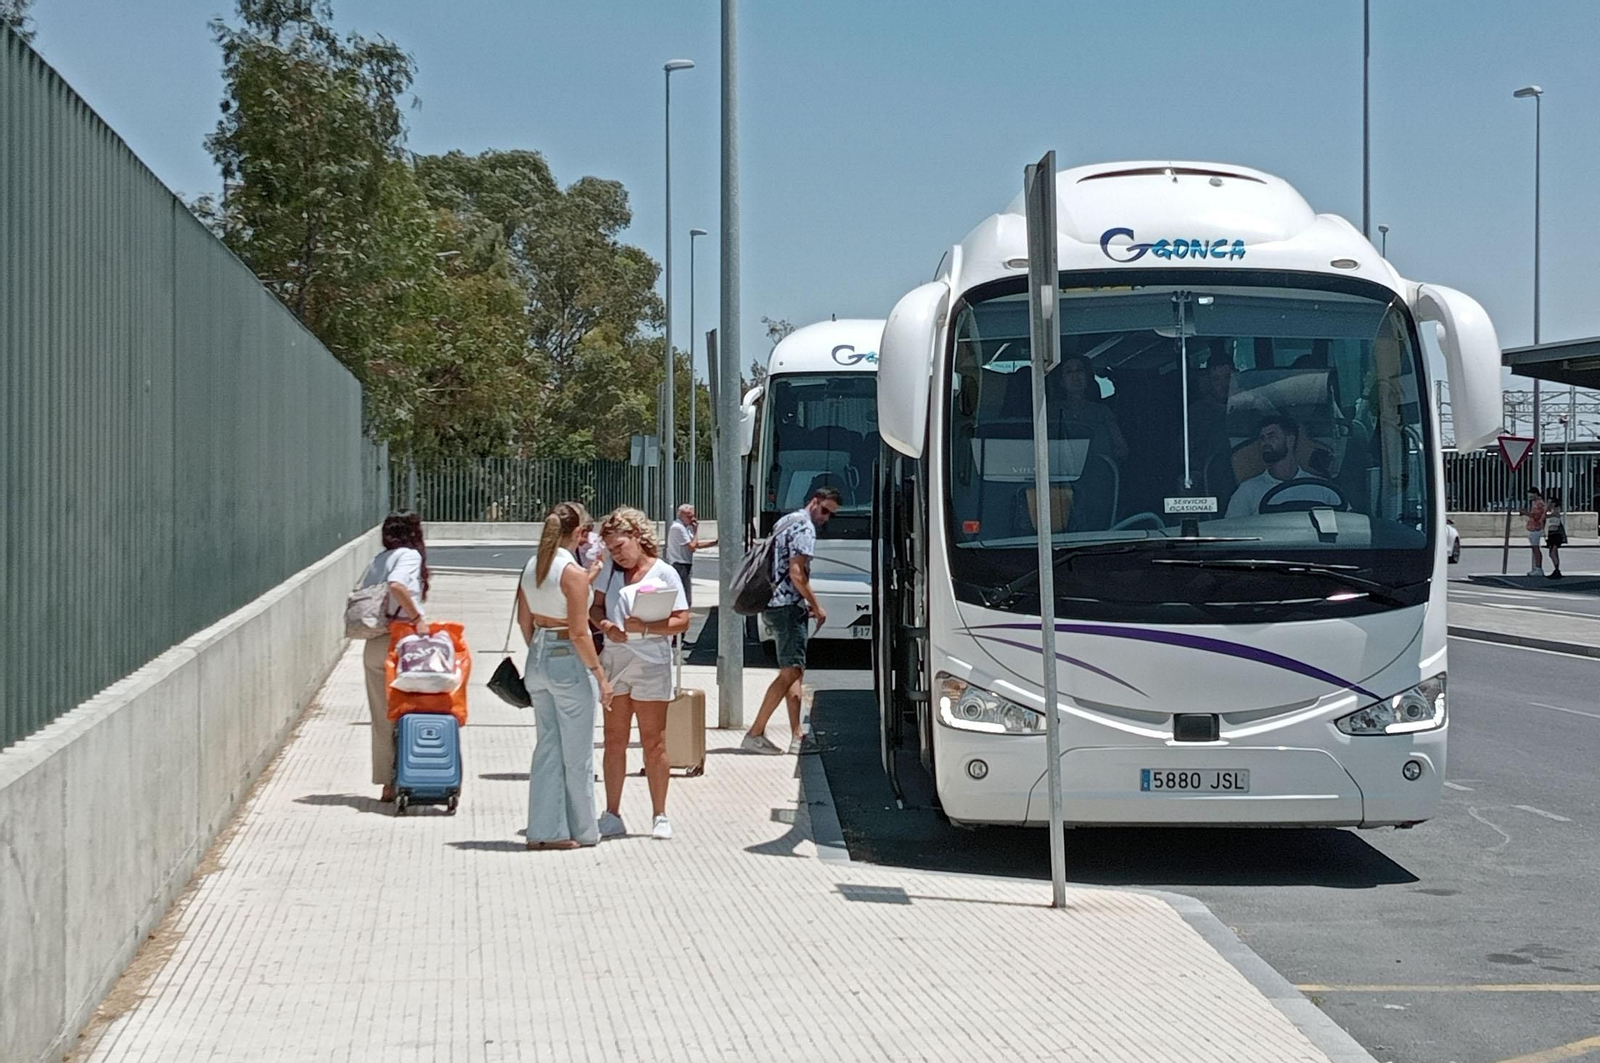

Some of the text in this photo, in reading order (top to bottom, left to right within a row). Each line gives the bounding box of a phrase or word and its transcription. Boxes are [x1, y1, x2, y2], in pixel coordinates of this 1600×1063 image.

[1151, 238, 1246, 260] GONCA
[1169, 504, 1214, 512] OCASIONAL
[1153, 772, 1244, 790] 5880 JSL
